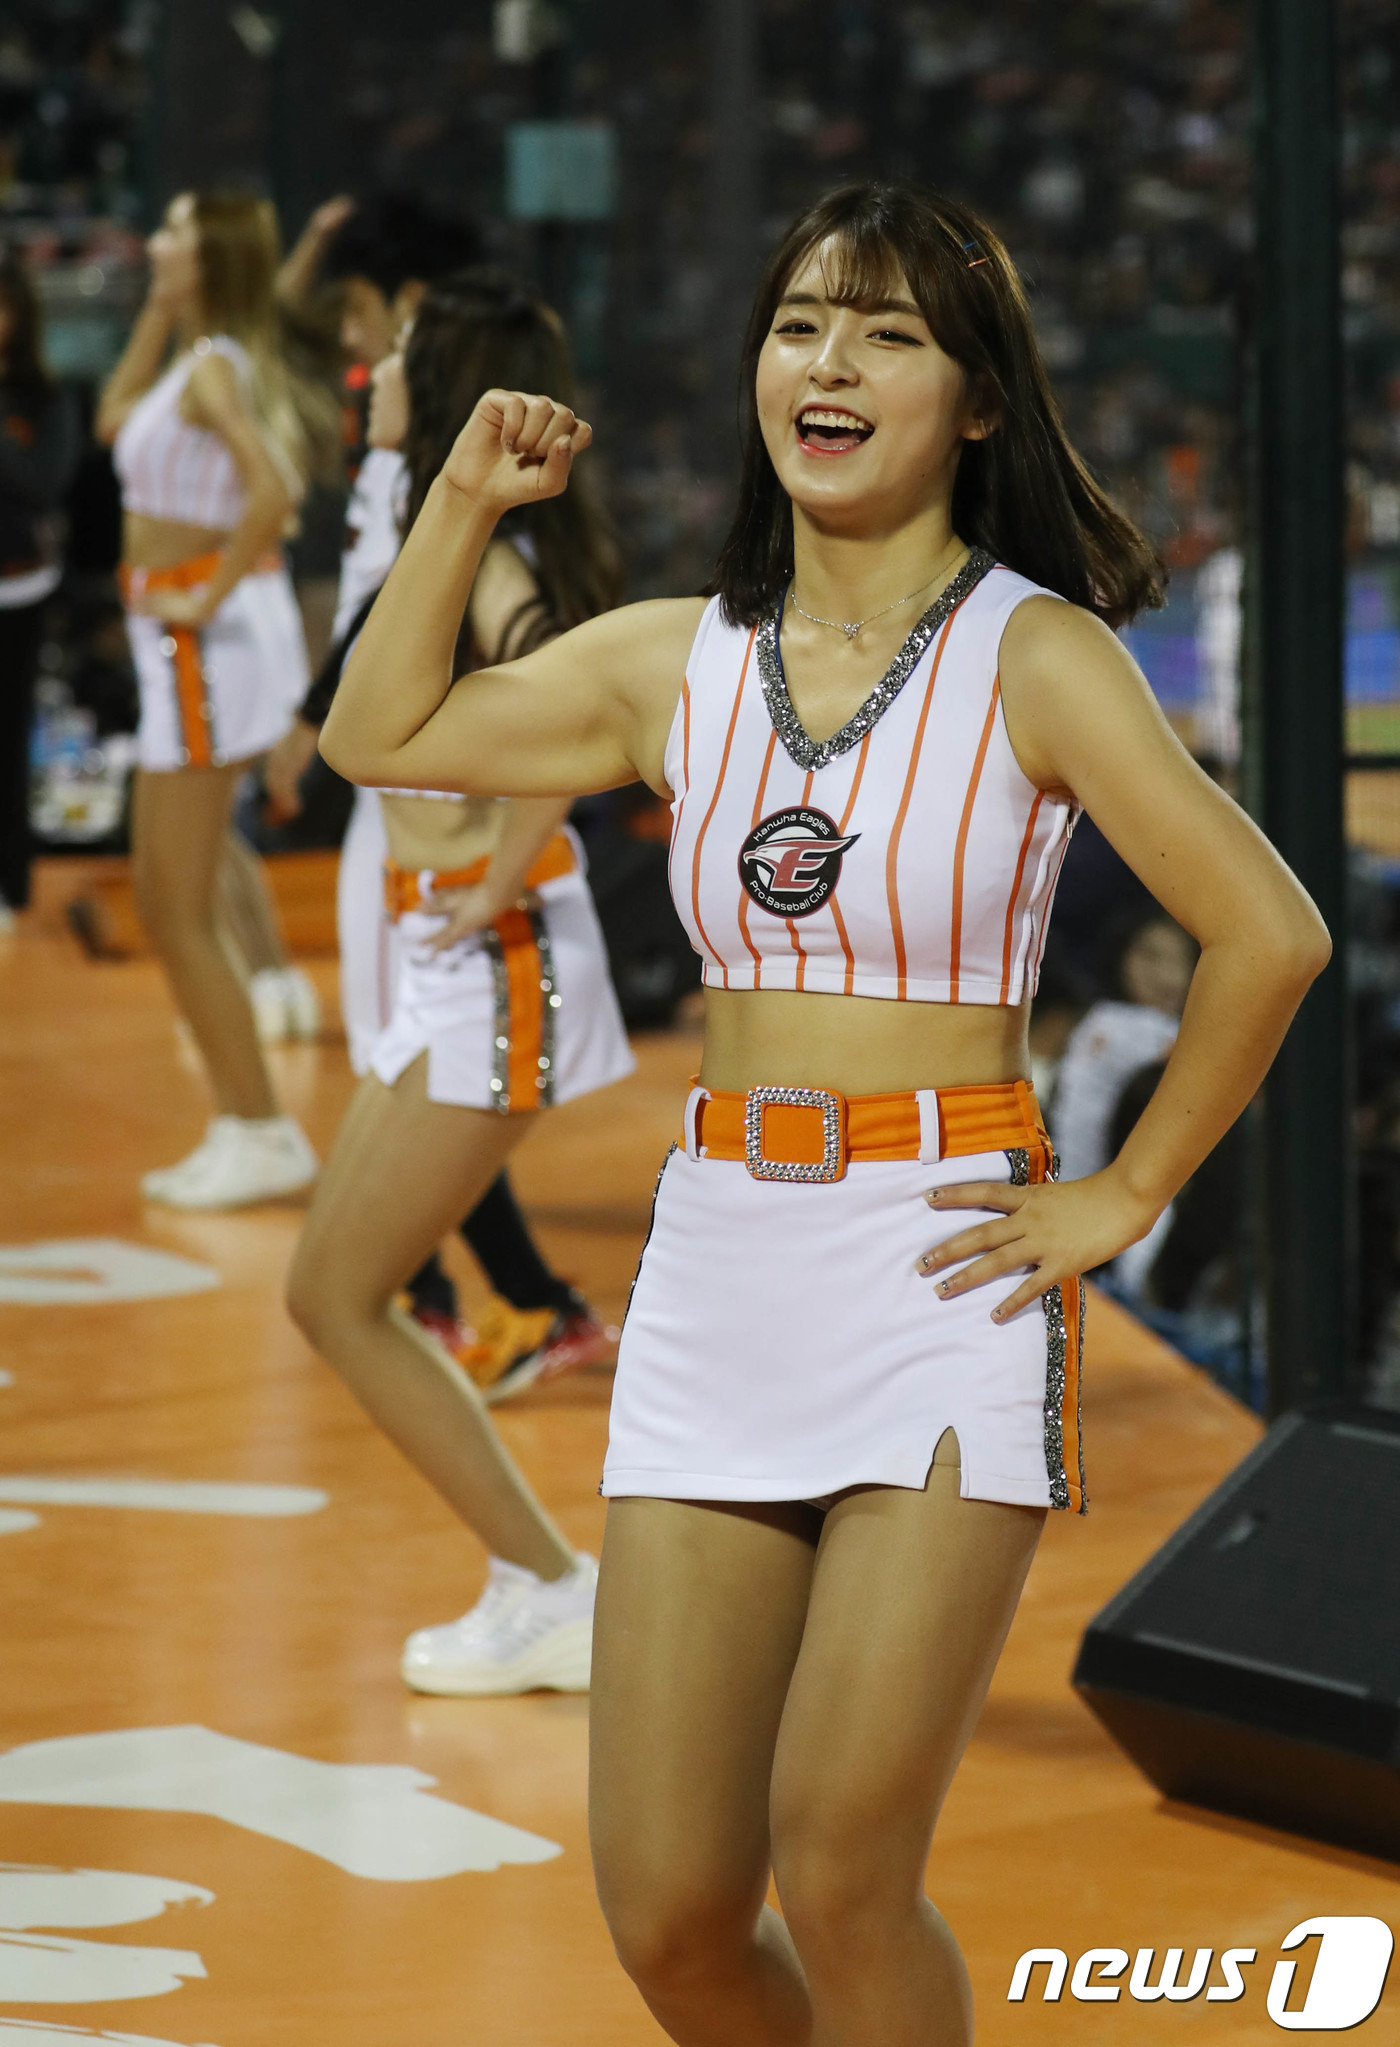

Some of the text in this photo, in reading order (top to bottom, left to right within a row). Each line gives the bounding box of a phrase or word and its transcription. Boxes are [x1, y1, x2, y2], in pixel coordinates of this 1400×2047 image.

[753, 812, 831, 842] Hanwha Eagles
[809, 882, 828, 904] Club
